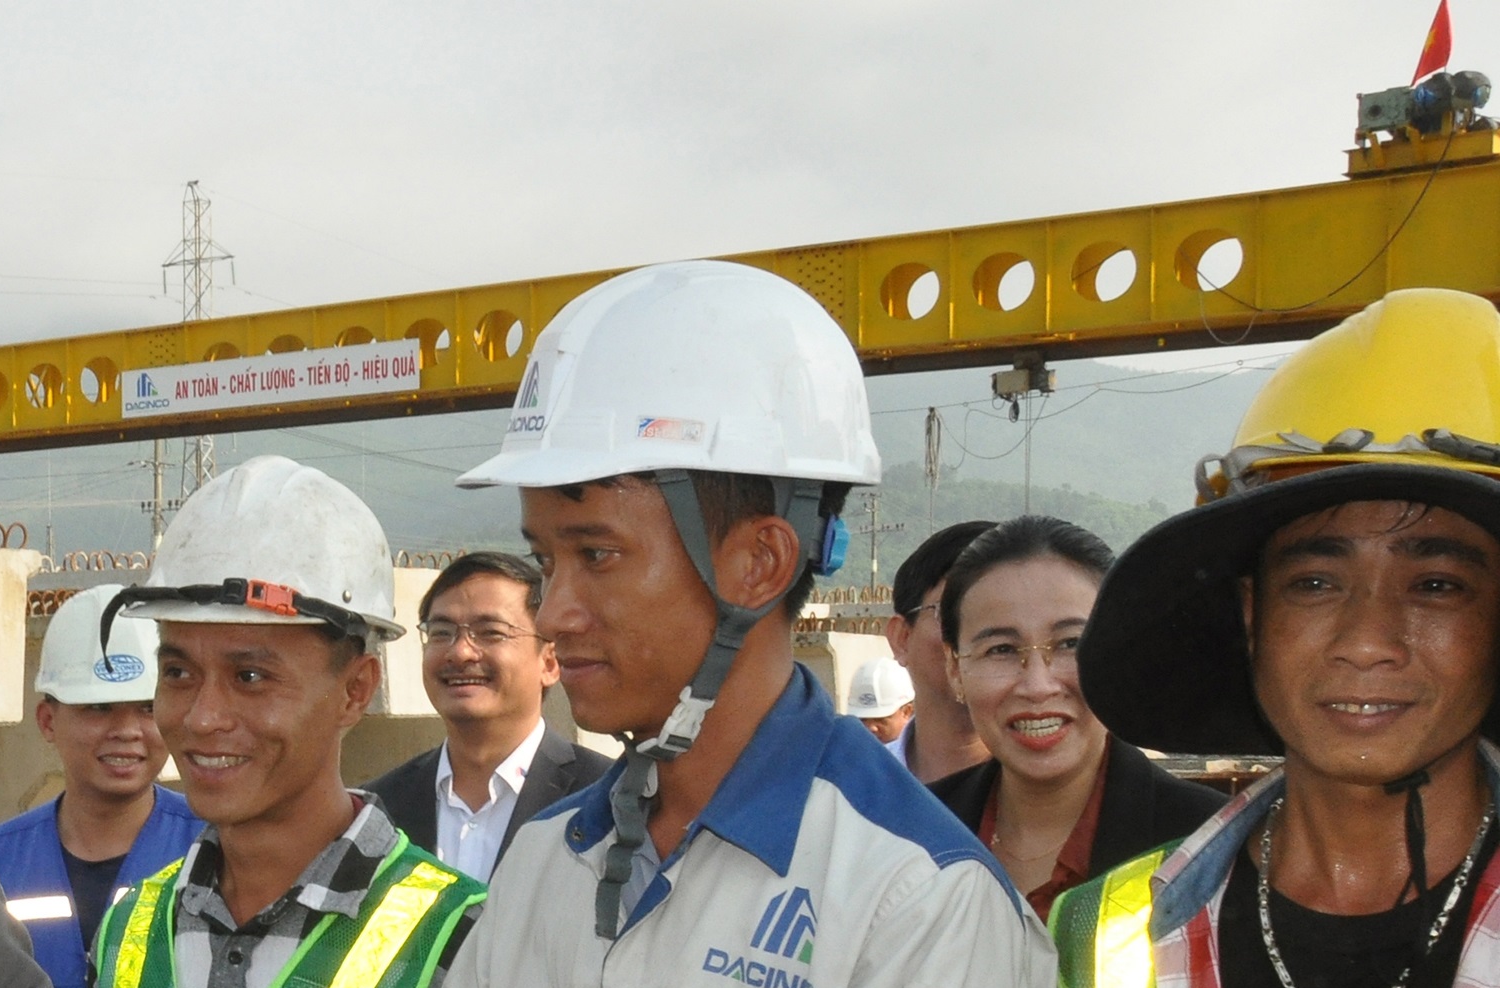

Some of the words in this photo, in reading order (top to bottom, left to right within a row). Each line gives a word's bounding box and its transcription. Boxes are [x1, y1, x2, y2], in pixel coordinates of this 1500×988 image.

[175, 381, 189, 399] AN
[192, 373, 218, 398] TOÀN
[229, 365, 257, 394] CHẤT
[260, 368, 296, 394] LƯỢNG
[307, 357, 331, 386] TIẾN
[334, 357, 350, 387] ĐỘ
[362, 354, 388, 384] HIỆU
[392, 349, 416, 379] QUẢ
[125, 399, 170, 411] DACINCO
